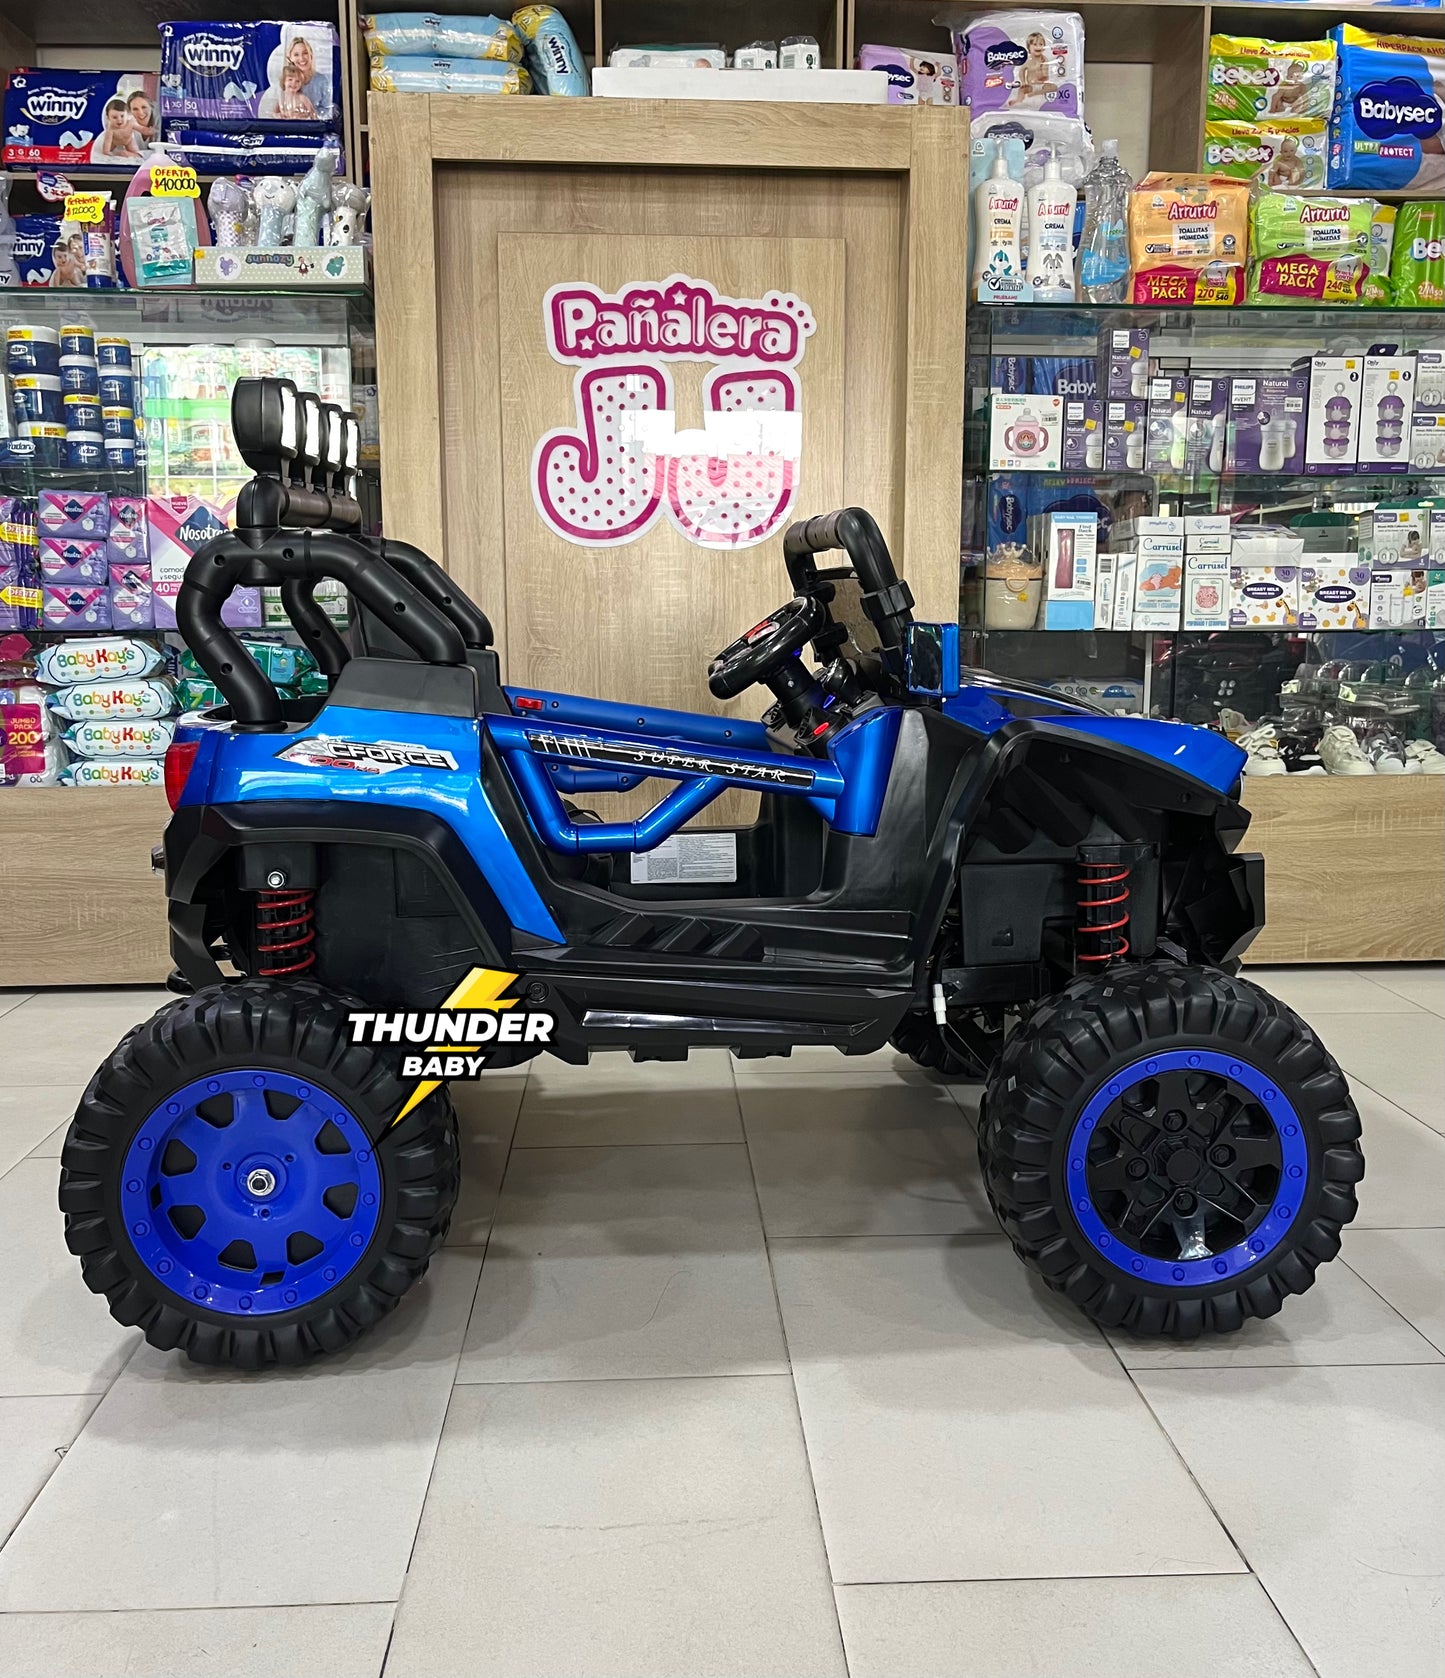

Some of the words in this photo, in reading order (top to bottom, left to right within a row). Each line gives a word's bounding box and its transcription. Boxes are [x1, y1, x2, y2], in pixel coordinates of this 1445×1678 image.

[186, 43, 244, 69] winny
[548, 35, 570, 76] winny
[987, 50, 1025, 63] Babysec
[1212, 64, 1279, 86] Bebex
[1058, 89, 1070, 100] XG
[29, 95, 87, 119] winny
[1359, 97, 1436, 124] Babysec
[8, 149, 14, 157] 3
[29, 148, 41, 158] 60
[1206, 144, 1274, 165] Bebex
[1354, 141, 1380, 153] ULTRA
[1379, 145, 1414, 158] PROTECT
[155, 168, 190, 177] OFERTA
[1168, 200, 1218, 220] Arrurrú
[1300, 205, 1350, 223] Arrurrú
[1178, 226, 1209, 234] TOALLITAS
[1312, 228, 1341, 236] TOALLITAS
[1276, 262, 1319, 276] MEGA
[1147, 275, 1189, 287] MEGA
[1278, 275, 1317, 289] PACK
[1150, 286, 1188, 299] PACK
[1197, 288, 1215, 299] 270
[561, 294, 793, 357] Pañalera
[1262, 379, 1289, 388] Natural
[1150, 407, 1172, 415] Natural
[1190, 408, 1212, 416] Natural
[1142, 537, 1183, 552] Carrusel
[159, 566, 185, 574] comod
[1187, 556, 1228, 570] Carrusel
[1280, 569, 1291, 578] 30
[1354, 571, 1366, 580] 30
[155, 583, 170, 593] 40
[56, 651, 96, 669] Baby
[96, 646, 136, 664] Kay's
[72, 692, 112, 708] Baby
[112, 689, 151, 706] Kay's
[8, 731, 38, 745] 200
[83, 728, 121, 744] Baby
[122, 726, 162, 742] Kay's
[327, 742, 450, 767] CFORCE
[633, 750, 714, 773] SUPER
[725, 763, 787, 783] STAR
[82, 767, 120, 783] Baby
[121, 765, 160, 782] Kay's
